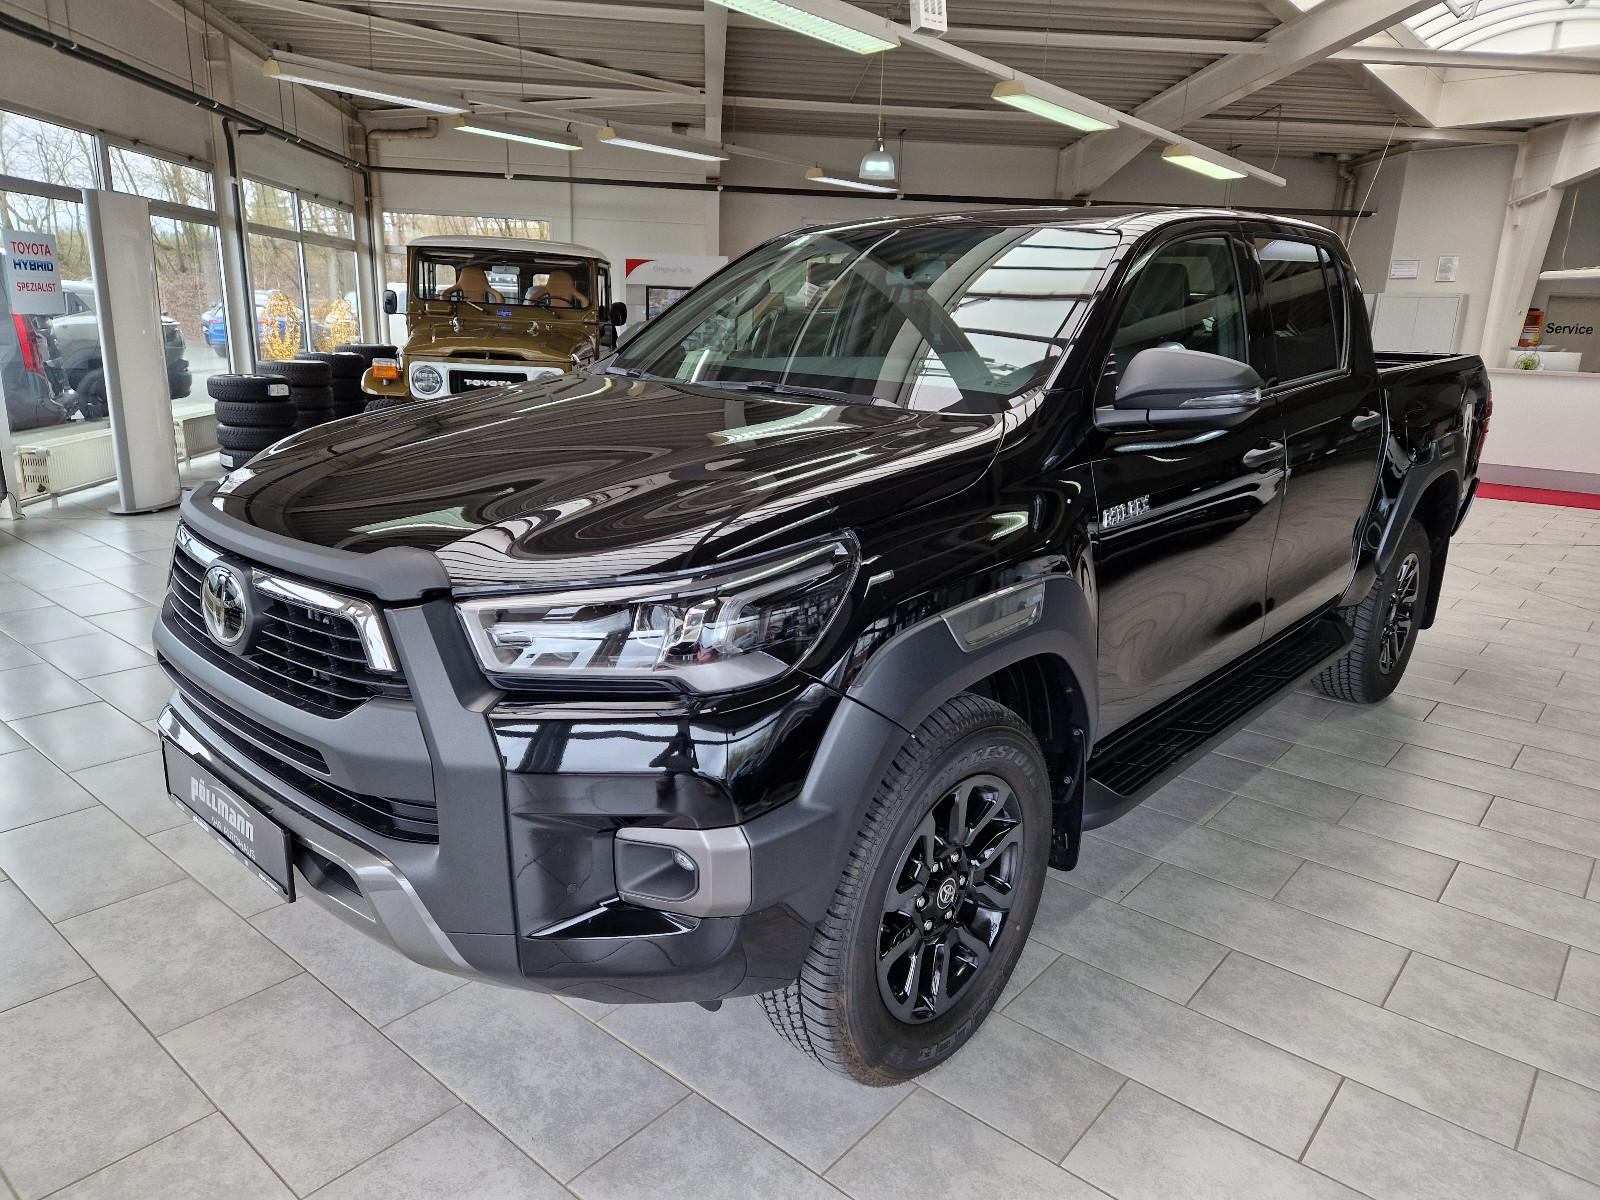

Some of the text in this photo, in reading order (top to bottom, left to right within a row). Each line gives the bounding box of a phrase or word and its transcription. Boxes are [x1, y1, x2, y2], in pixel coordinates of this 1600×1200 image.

[11, 241, 51, 256] TOYOTA
[13, 259, 54, 271] HYBRID
[16, 282, 56, 293] SPEZIALIST
[1546, 322, 1594, 335] Service
[464, 379, 512, 387] TOYOTA
